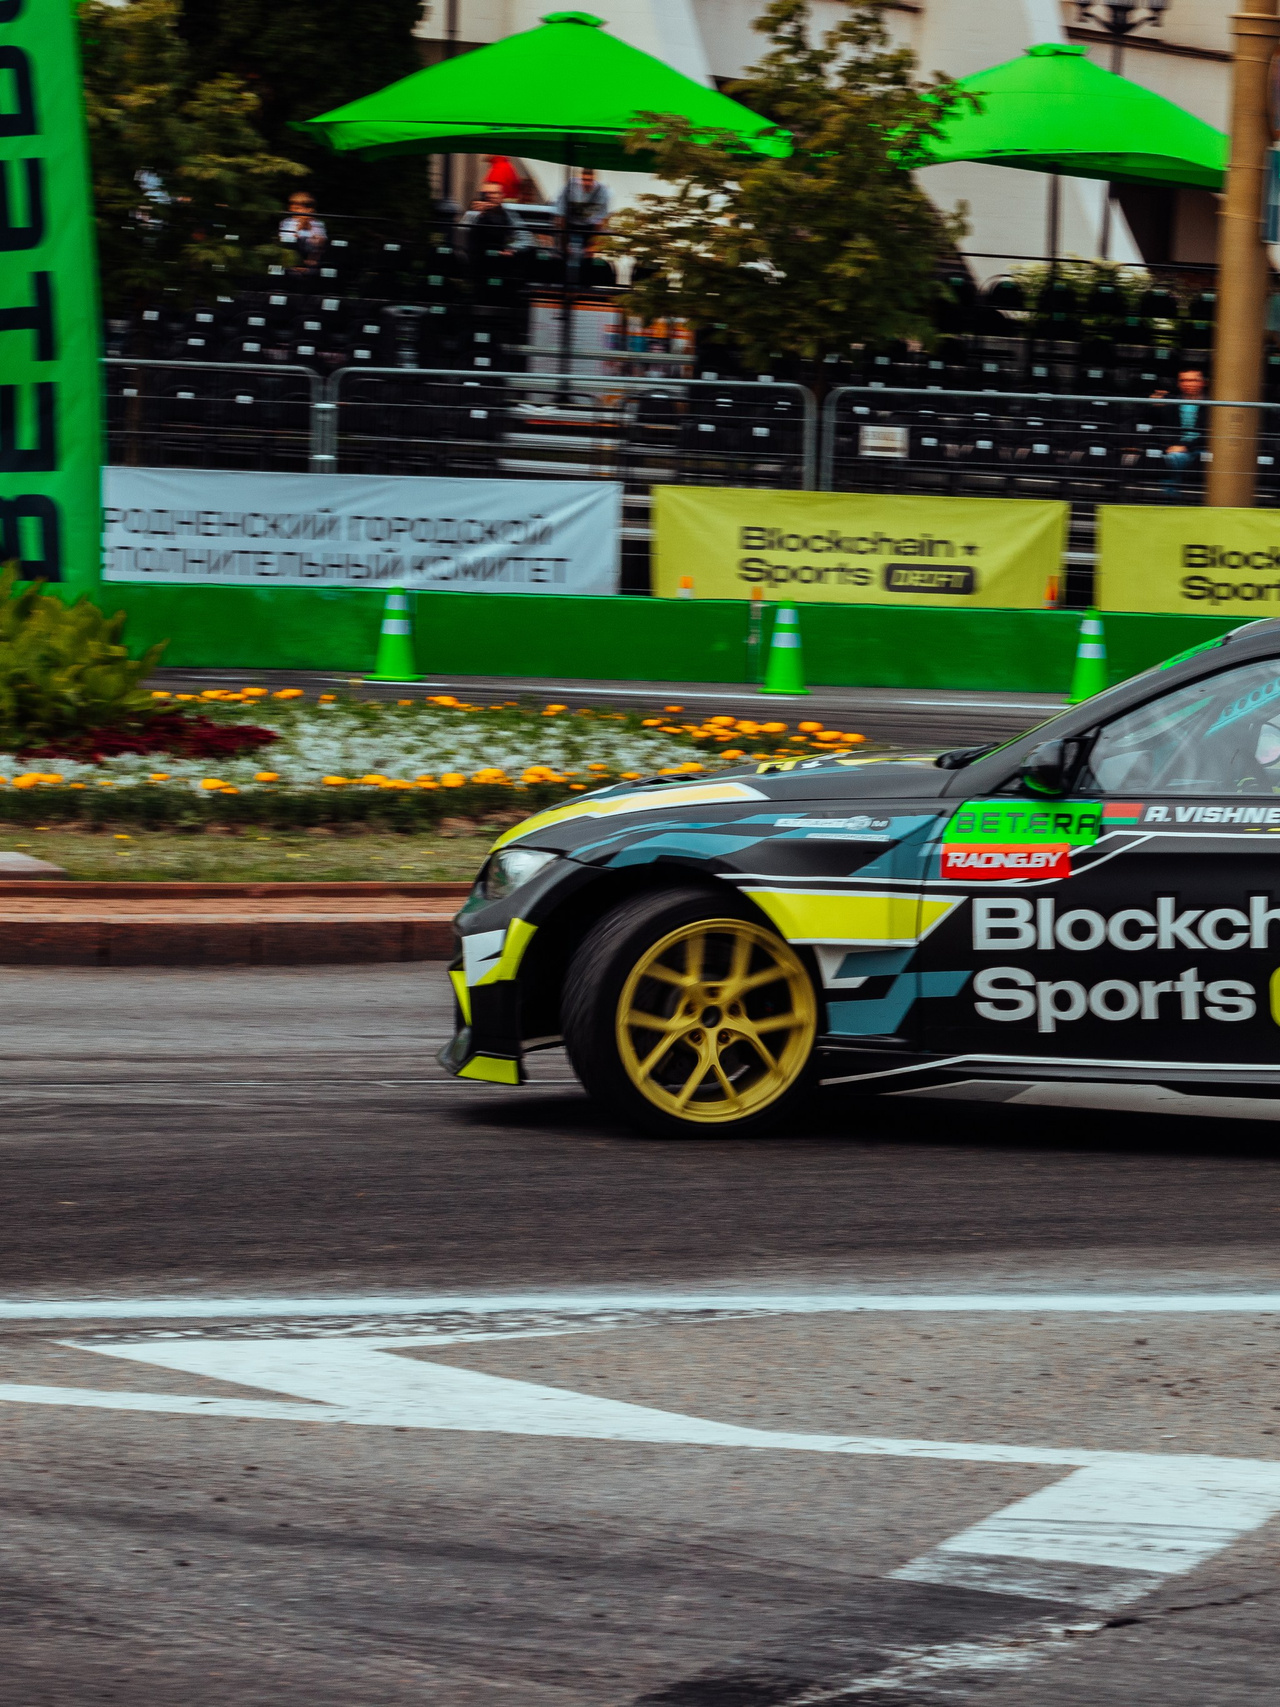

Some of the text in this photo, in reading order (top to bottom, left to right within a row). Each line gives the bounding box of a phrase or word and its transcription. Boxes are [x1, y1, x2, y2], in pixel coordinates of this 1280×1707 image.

[100, 507, 552, 549] РОДНЕНСКИЙ ГОРОДСКОЙ
[740, 526, 955, 557] Blockchain
[100, 545, 573, 583] ПОЛНИТЕЛЬНЫЙ КОМИТЕТ
[738, 557, 874, 588] Sports
[973, 966, 1257, 1033] Sports
